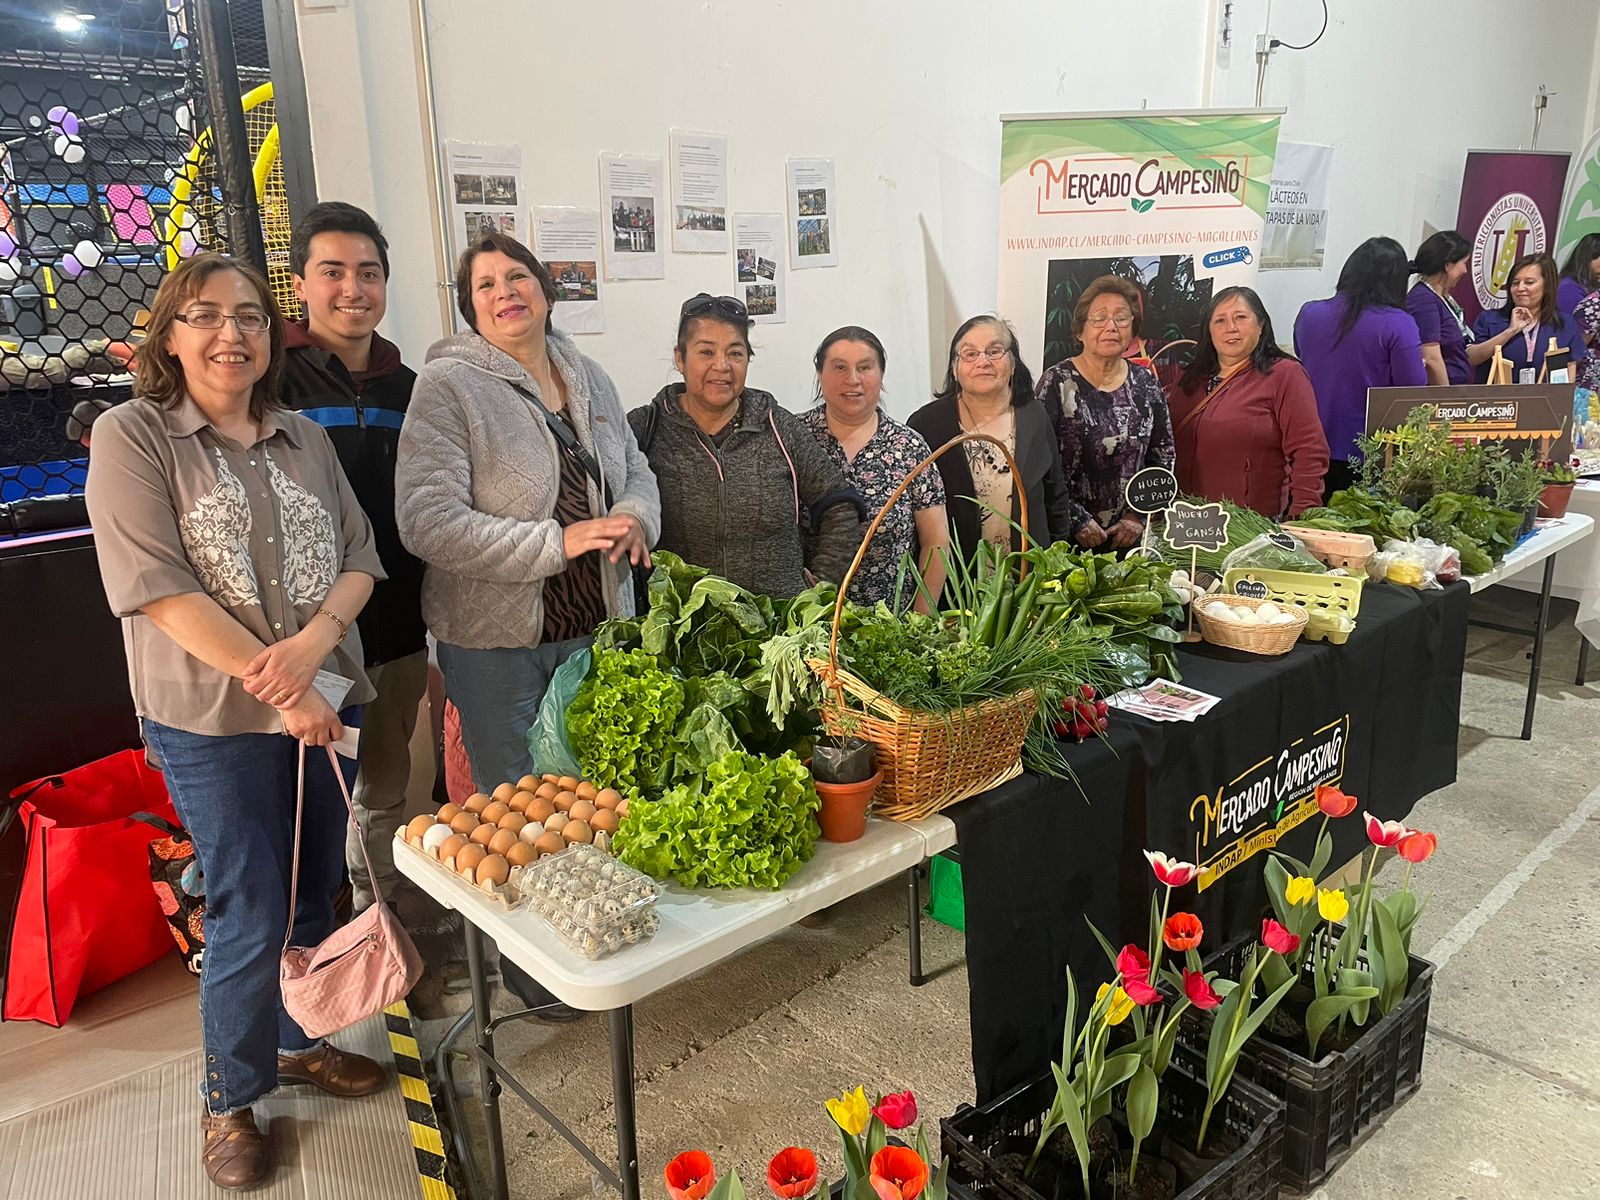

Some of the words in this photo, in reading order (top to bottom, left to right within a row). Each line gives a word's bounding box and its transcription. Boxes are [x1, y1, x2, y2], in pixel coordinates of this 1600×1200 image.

[1029, 158, 1132, 205] MERCADO
[1135, 158, 1240, 198] CAMPESINO
[1269, 187, 1299, 204] LÁCTEOS
[1299, 191, 1308, 204] EN
[1286, 212, 1295, 225] DE
[1296, 212, 1304, 226] LA
[1305, 213, 1320, 226] VIDA
[1474, 197, 1513, 268] NUTRICIONISTAS
[1006, 230, 1259, 250] WWW.INDAP.CL/MERCADO-CAMPESINO-MAGALLANES
[1208, 251, 1236, 264] CLICK
[1475, 271, 1482, 284] DE
[1467, 403, 1515, 418] CAMPESINO
[1138, 477, 1173, 489] HUEVO
[1134, 494, 1145, 502] DE
[1151, 489, 1174, 501] PATA
[1177, 510, 1209, 520] HUEVO
[1185, 526, 1222, 538] GANSA
[1189, 776, 1271, 846] MERCADO
[1273, 727, 1342, 802] CAMPESINO
[1214, 848, 1243, 876] INDAP
[1281, 818, 1290, 831] de
